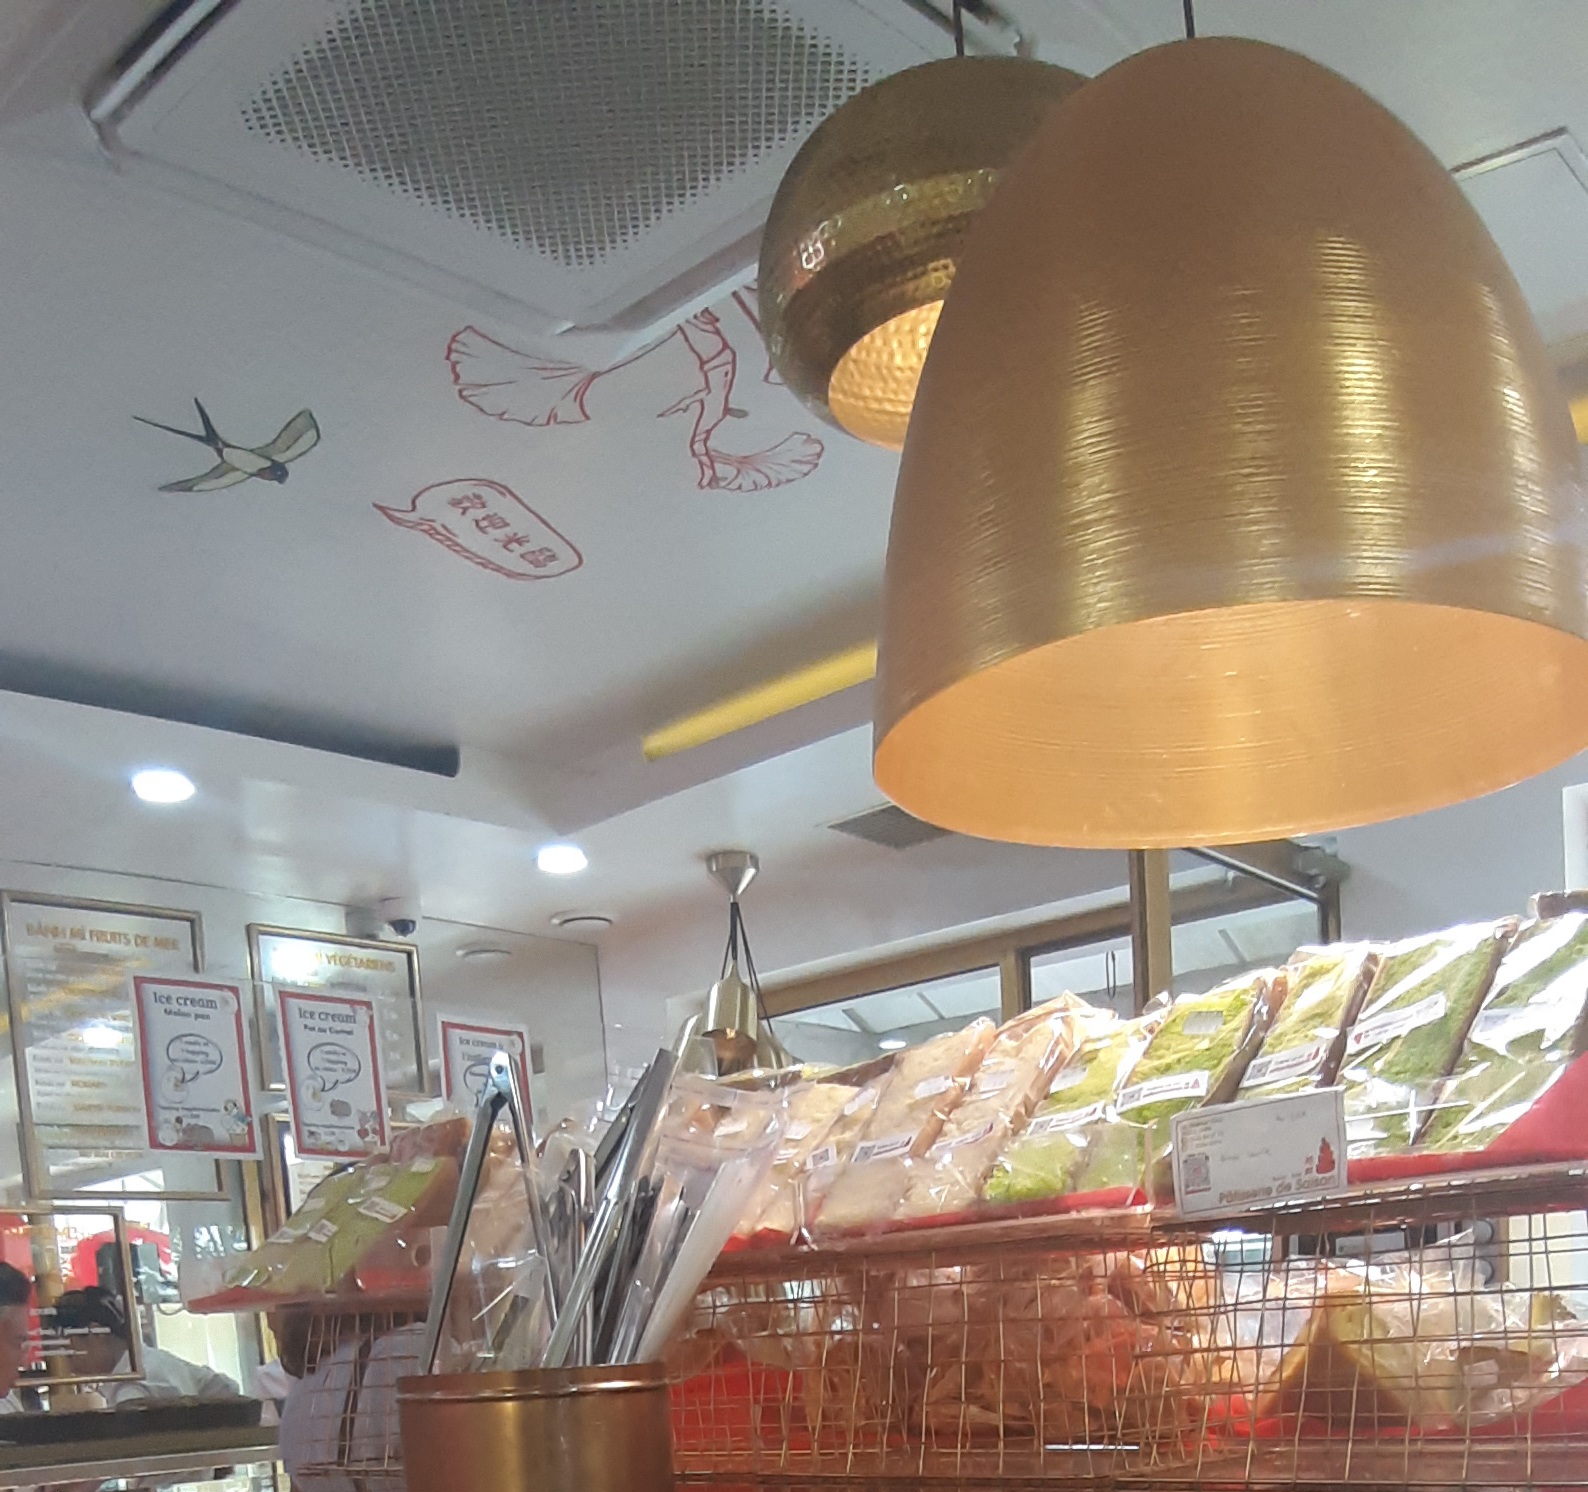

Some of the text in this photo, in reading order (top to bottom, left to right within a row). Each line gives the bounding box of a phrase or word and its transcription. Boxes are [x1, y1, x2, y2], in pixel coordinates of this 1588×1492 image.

[152, 992, 219, 1011] Ice cream
[298, 1006, 357, 1025] Ice cream
